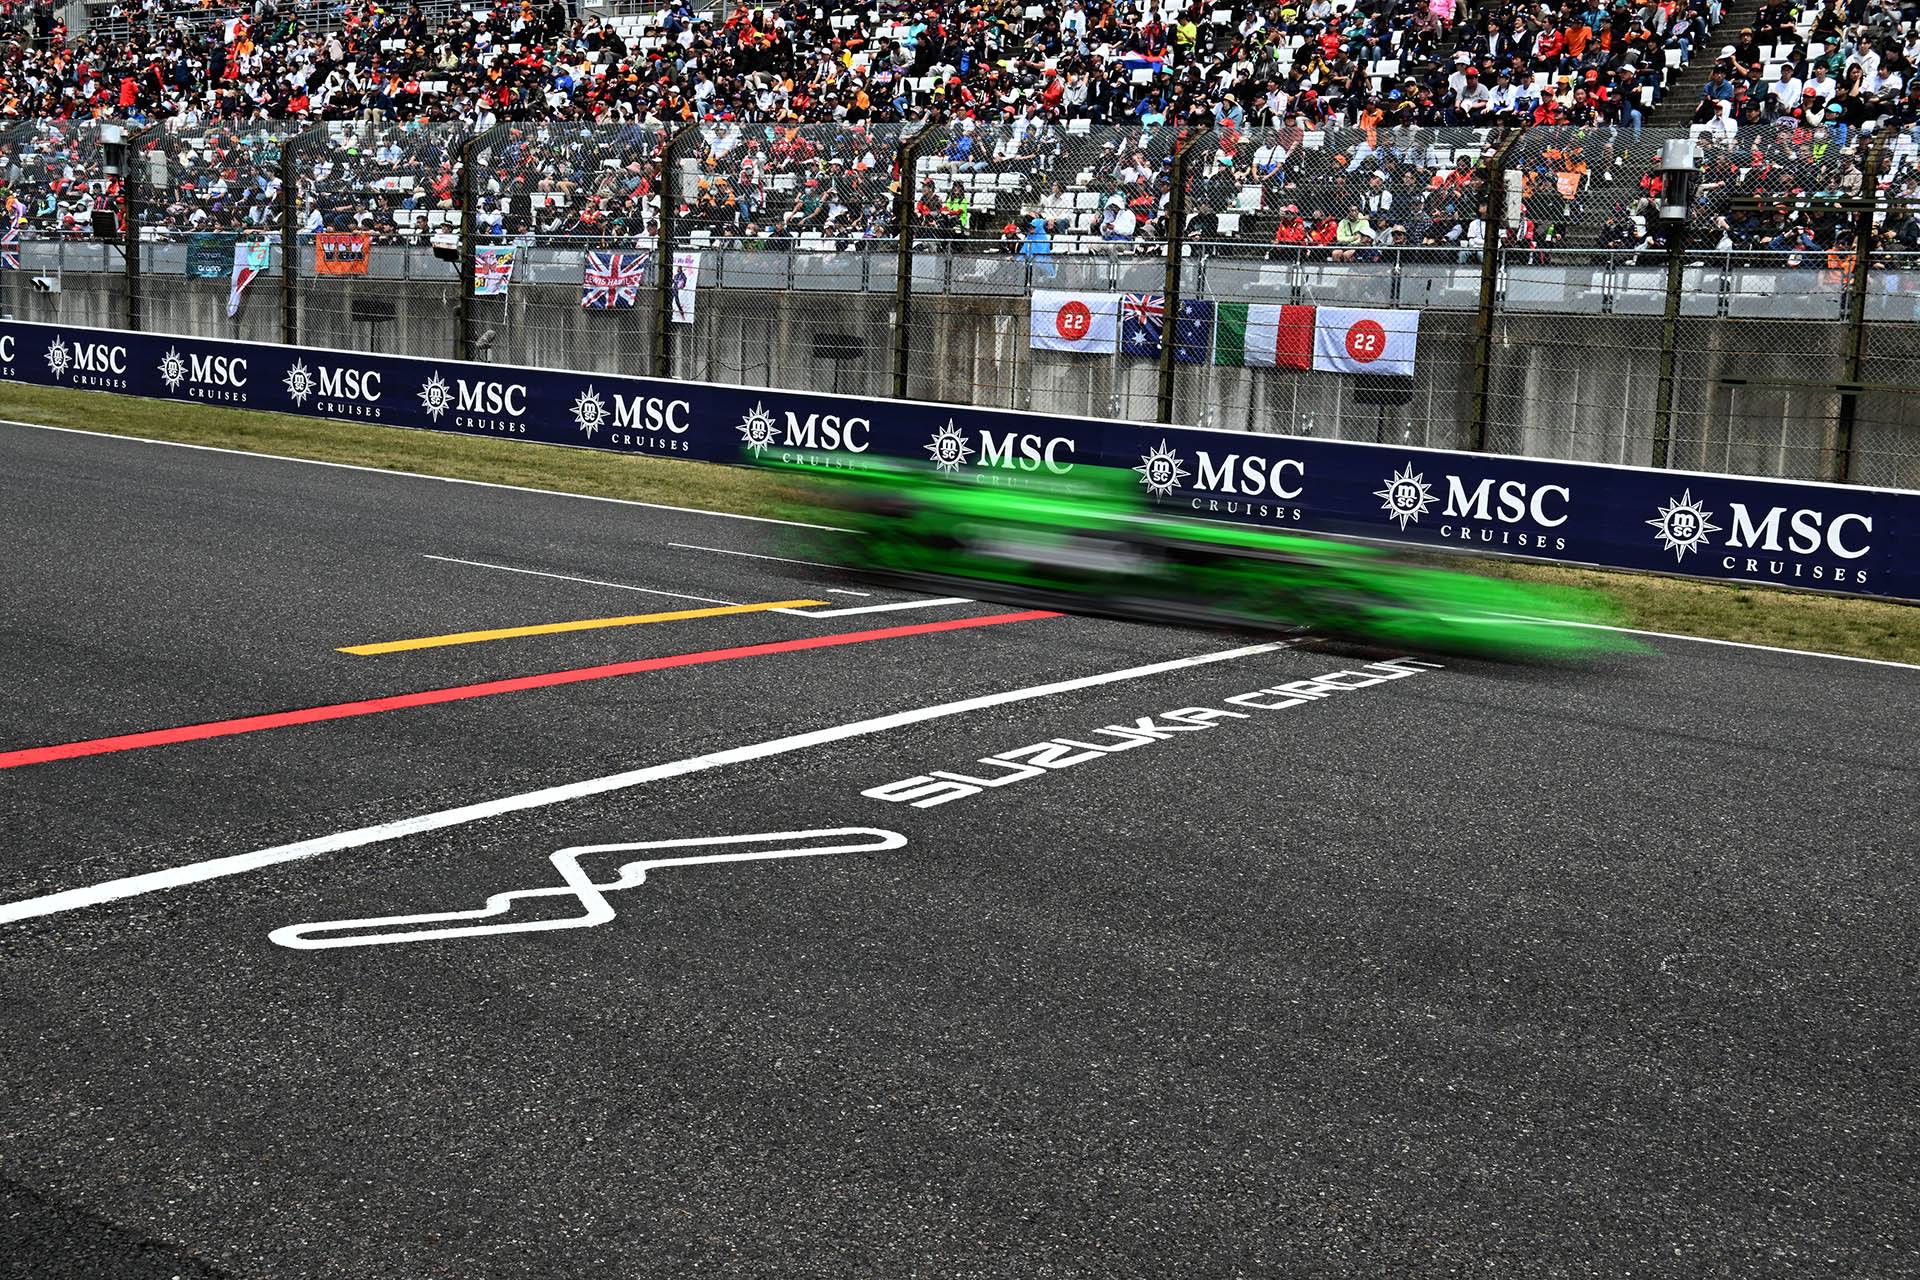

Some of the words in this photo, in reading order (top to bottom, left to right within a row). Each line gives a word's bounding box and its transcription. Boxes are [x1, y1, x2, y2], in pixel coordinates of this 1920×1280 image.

[1064, 313, 1084, 330] 22
[73, 342, 126, 374] MSC
[1354, 333, 1376, 351] 22
[73, 375, 127, 388] CRUISES
[190, 354, 246, 386] MSC
[318, 366, 380, 401] MSC
[190, 388, 247, 402] CRUISES
[318, 402, 380, 417] CRUISES
[456, 380, 526, 416] MSC
[456, 417, 525, 432] CRUISES
[613, 394, 689, 433] MSC
[612, 434, 689, 451] CRUISES
[784, 411, 870, 453] MSC
[977, 430, 1075, 475] MSC
[1193, 451, 1304, 499] MSC
[1192, 498, 1301, 520] CRUISES
[1442, 475, 1569, 527] MSC
[1440, 525, 1566, 550] CRUISES
[1725, 503, 1872, 558] MSC
[1722, 557, 1867, 583] CRUISES
[860, 706, 1251, 809] SUZUKA
[1223, 656, 1445, 710] CIRCUIT
